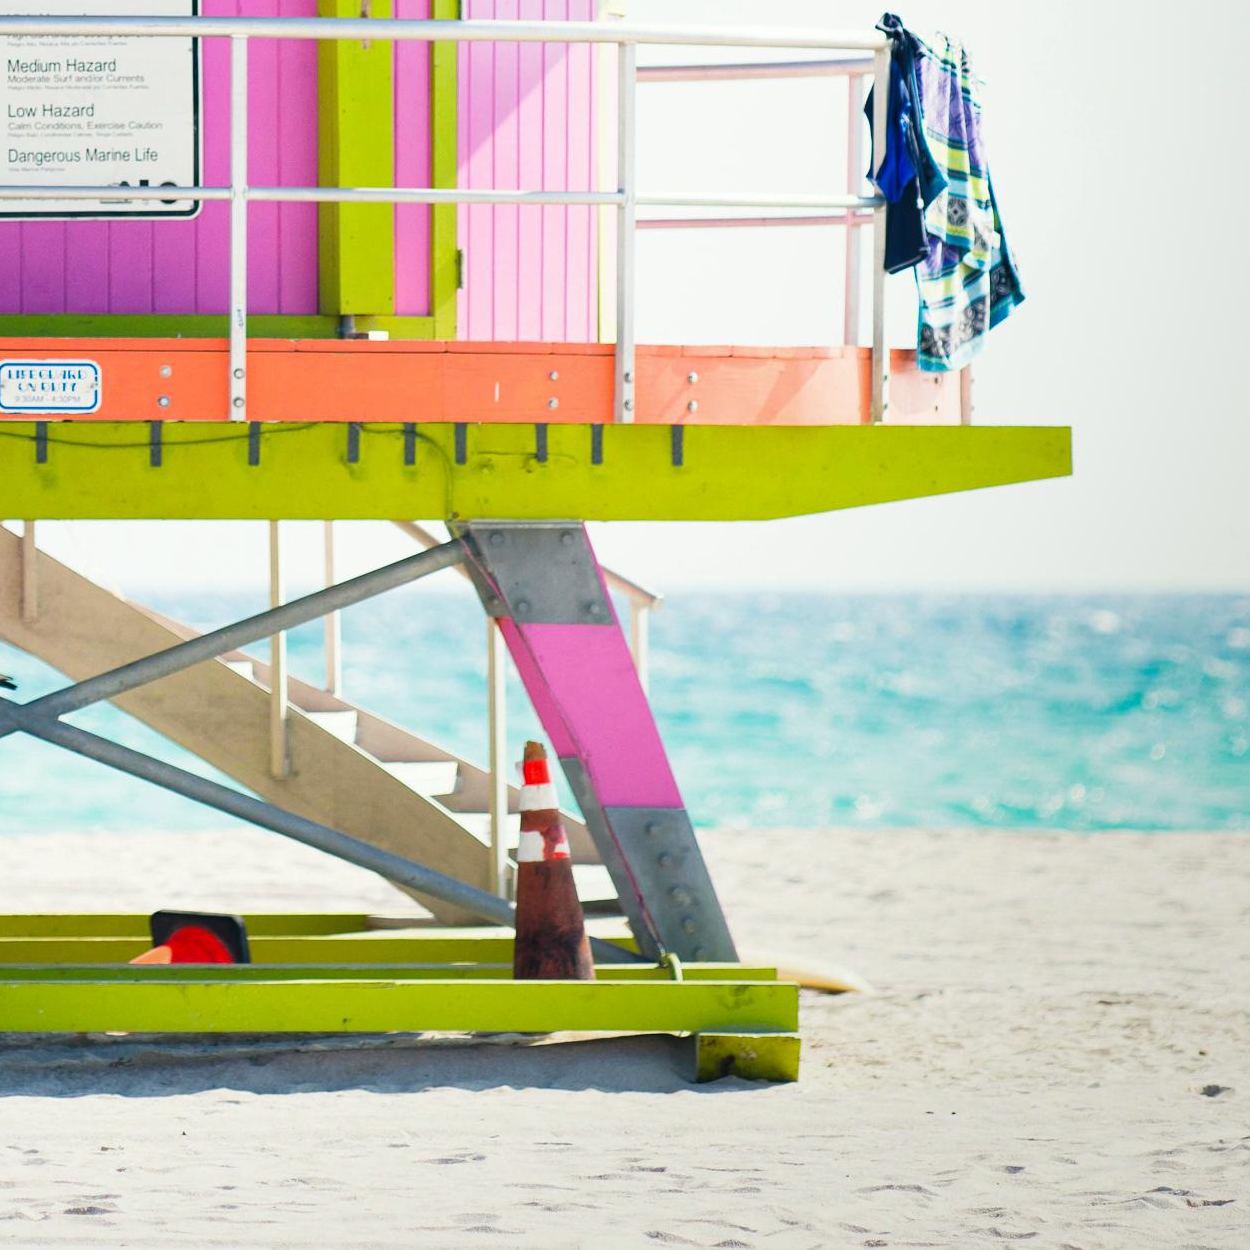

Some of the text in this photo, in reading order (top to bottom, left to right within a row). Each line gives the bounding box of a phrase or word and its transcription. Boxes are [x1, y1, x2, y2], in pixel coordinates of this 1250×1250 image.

[7, 58, 116, 73] Medium Hazard
[8, 74, 145, 83] Moderate Surf and/or Currents
[7, 104, 95, 118] Low Hazard
[8, 121, 163, 131] Calm Conditions, Exercise Caution
[8, 147, 158, 166] Dangerous Marine Life
[41, 382, 78, 392] DUTY
